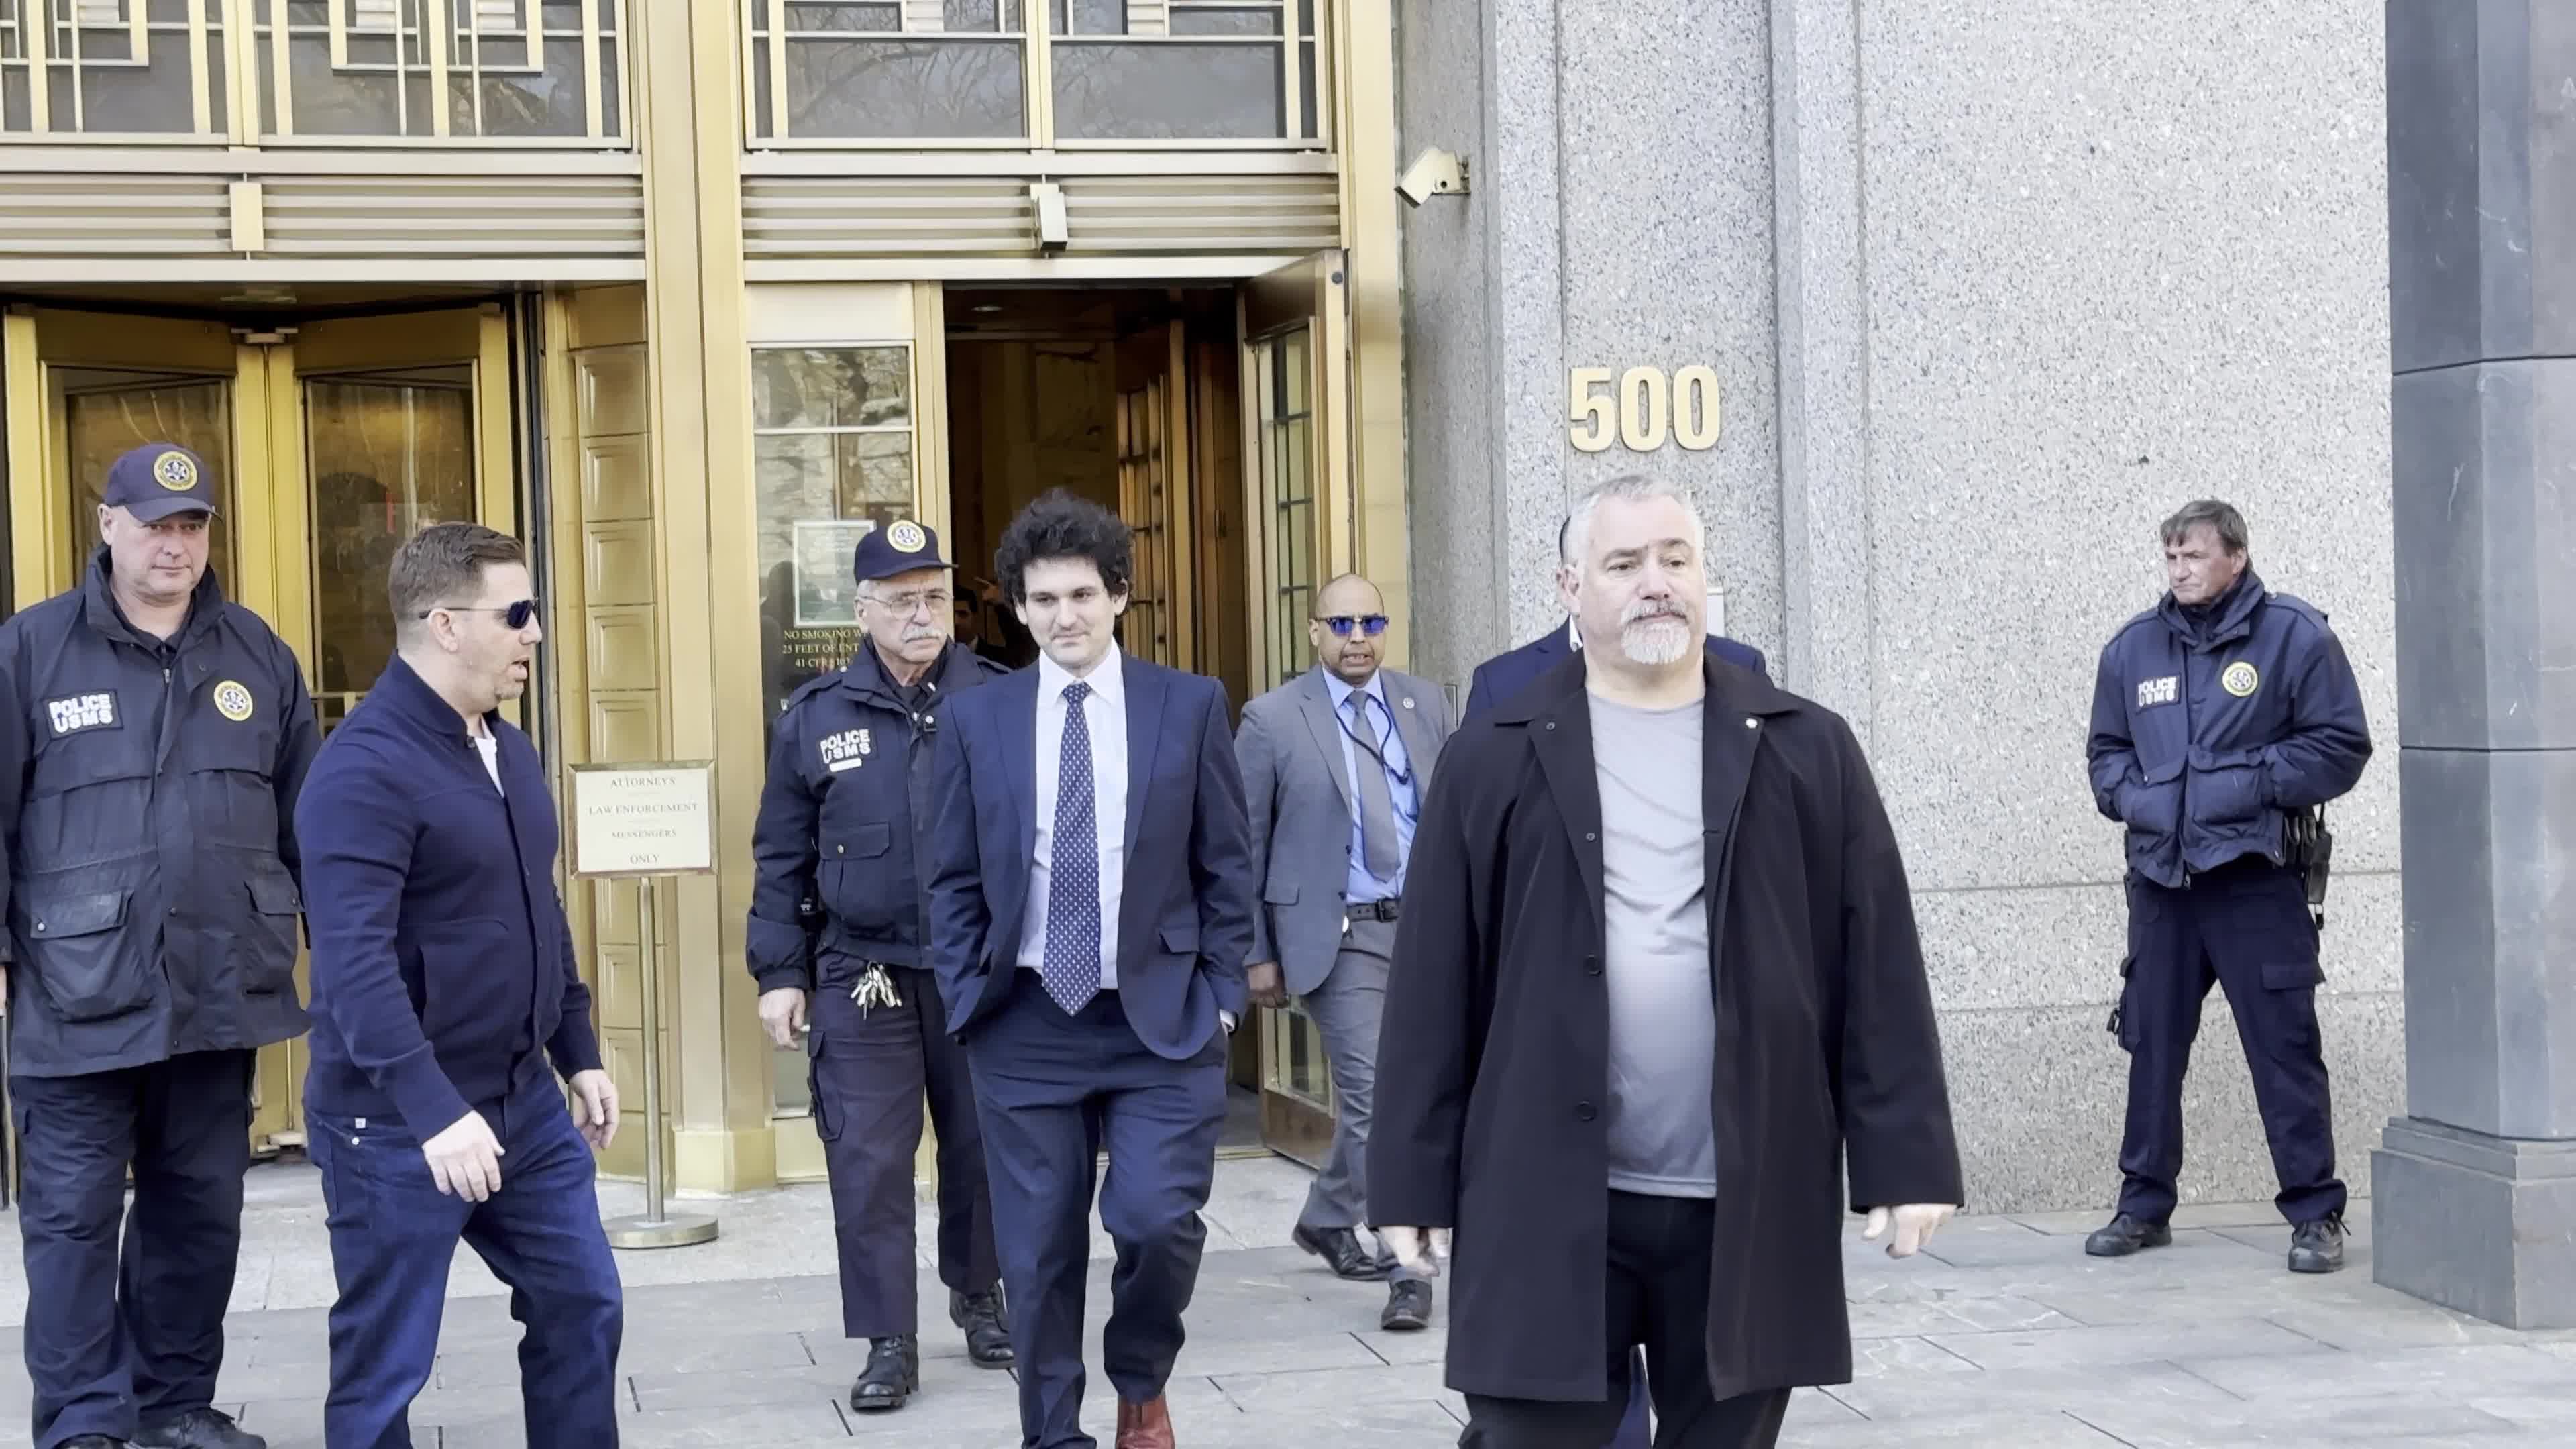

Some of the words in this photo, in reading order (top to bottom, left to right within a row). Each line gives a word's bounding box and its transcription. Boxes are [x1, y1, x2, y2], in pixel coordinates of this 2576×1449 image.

[1570, 365, 1721, 452] 500
[784, 630, 800, 639] NO
[802, 629, 851, 639] SMOKING
[783, 644, 792, 654] 25
[794, 643, 819, 653] FEET
[822, 643, 835, 653] OF
[2138, 676, 2176, 694] POLICE
[48, 694, 112, 720] POLICE
[53, 708, 113, 733] USMS
[820, 729, 870, 750] POLICE
[822, 742, 871, 764] USMS
[611, 777, 676, 788] ATTORNEYS
[588, 804, 612, 815] LAW
[615, 802, 698, 814] ENFORCEMENT
[611, 828, 677, 839] MESSENGERS
[629, 853, 660, 865] ONLY
